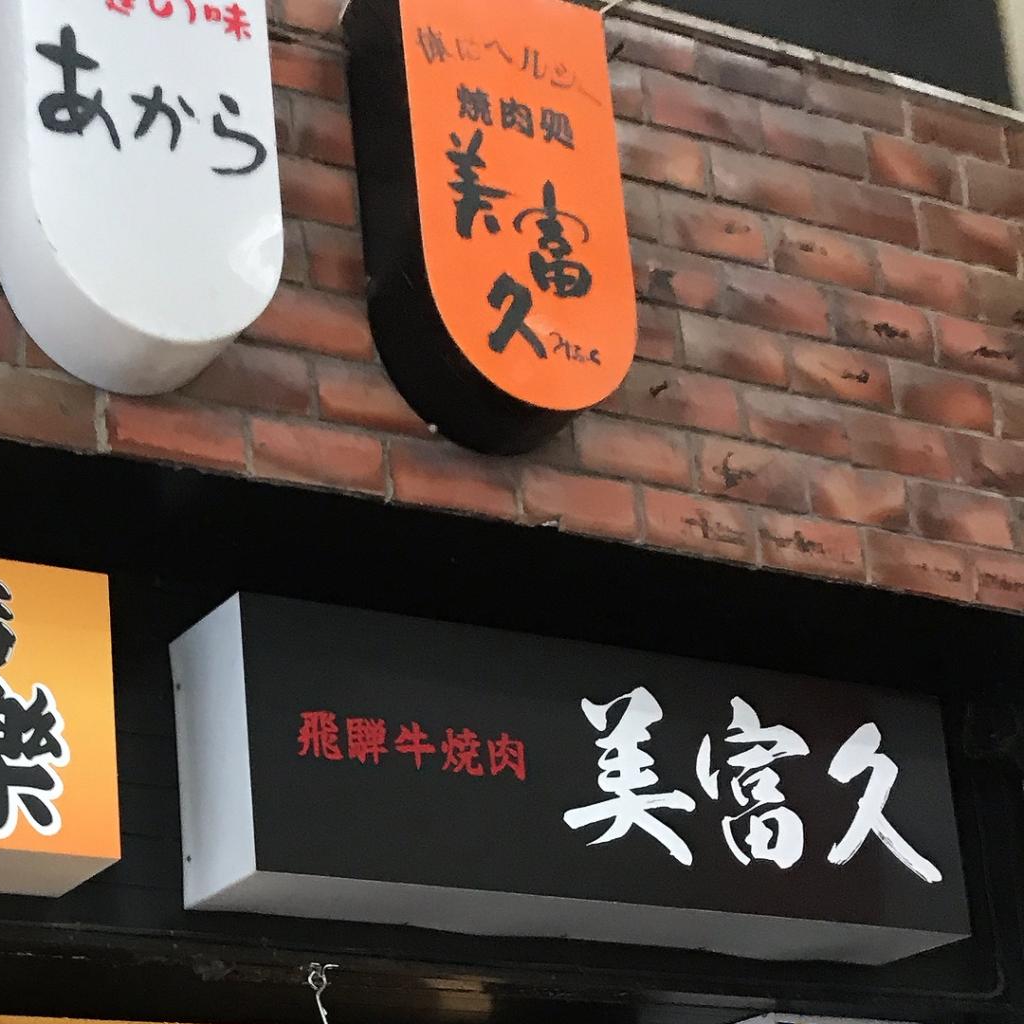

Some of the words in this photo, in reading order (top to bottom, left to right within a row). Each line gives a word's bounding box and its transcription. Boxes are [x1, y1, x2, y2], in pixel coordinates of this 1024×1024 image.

[456, 82, 576, 150] 焼肉処
[446, 129, 593, 360] 美富久
[297, 709, 528, 781] 飛騨牛焼肉
[562, 685, 943, 885] 美富久
